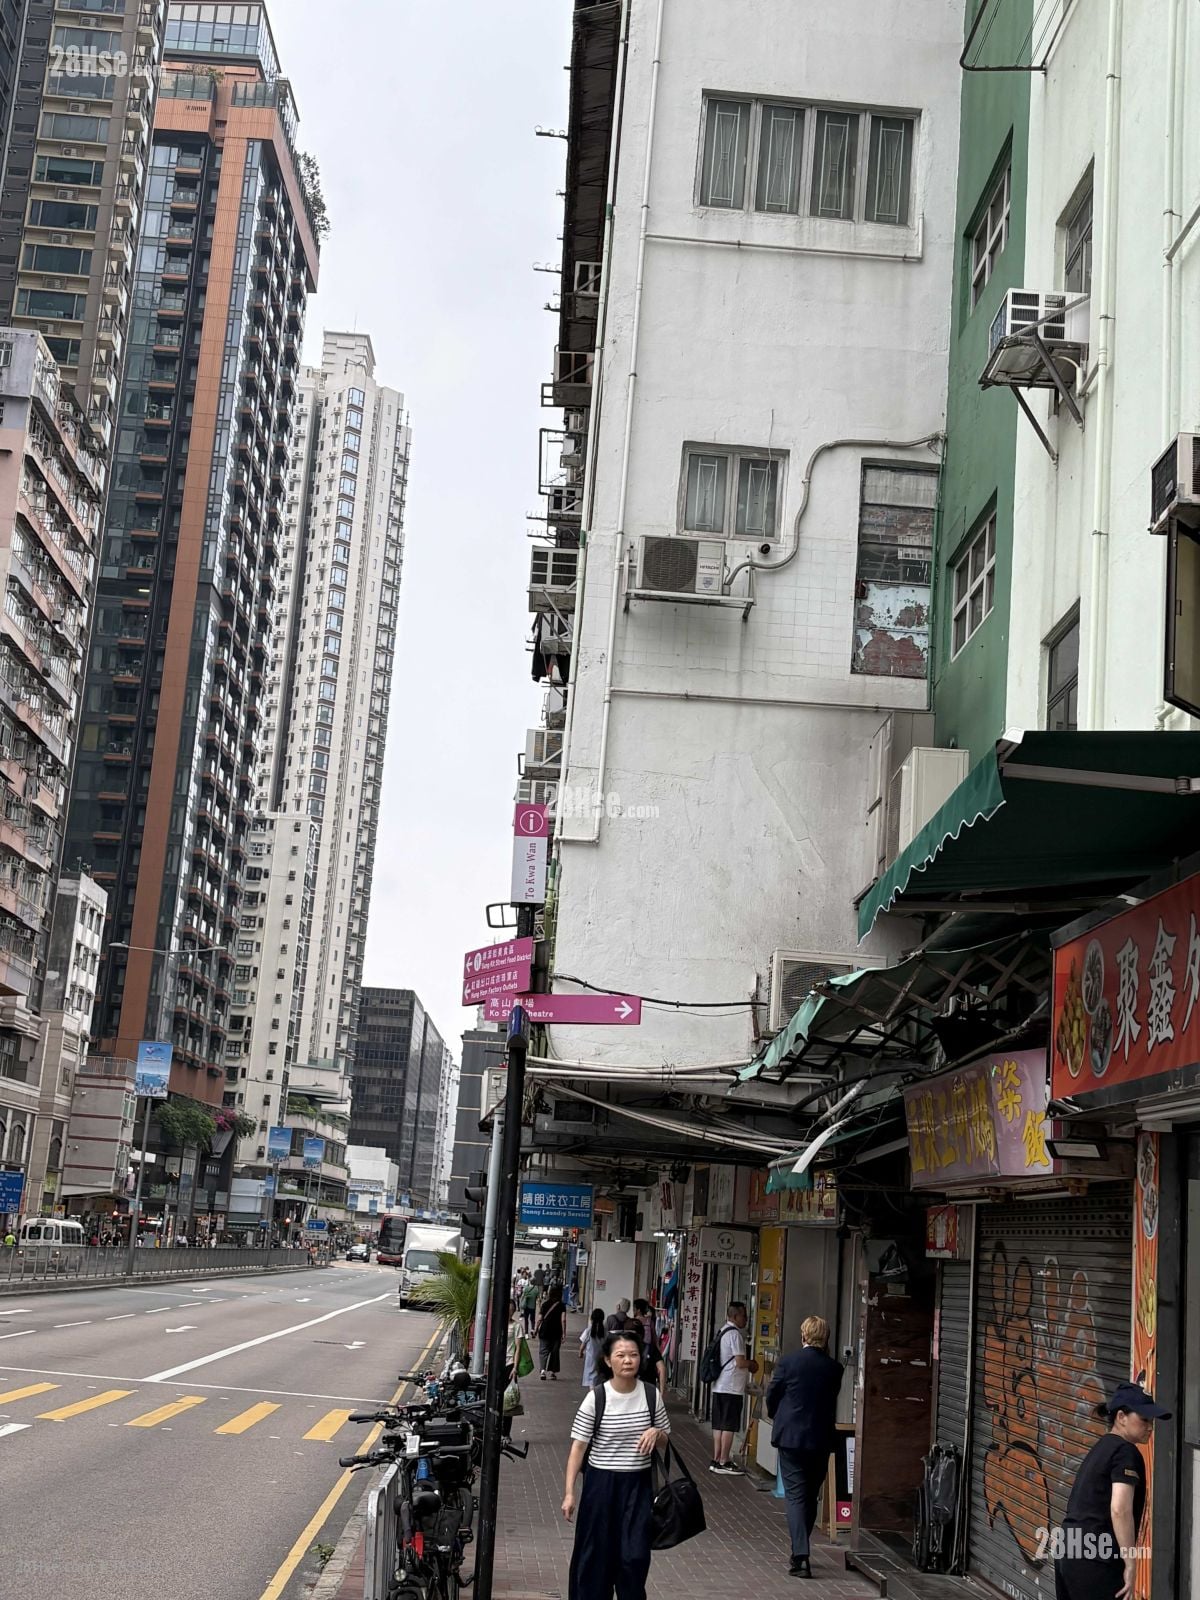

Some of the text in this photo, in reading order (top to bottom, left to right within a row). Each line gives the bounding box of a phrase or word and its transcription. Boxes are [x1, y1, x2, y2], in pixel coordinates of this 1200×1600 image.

[525, 842, 536, 899] To Kwa Wan
[496, 958, 506, 966] Street
[507, 955, 516, 963] Food
[516, 952, 532, 962] District
[488, 985, 502, 995] Factory
[502, 981, 518, 991] Outlets
[489, 1009, 499, 1017] Ko
[542, 1209, 567, 1217] Laundry
[568, 1210, 590, 1218] Service
